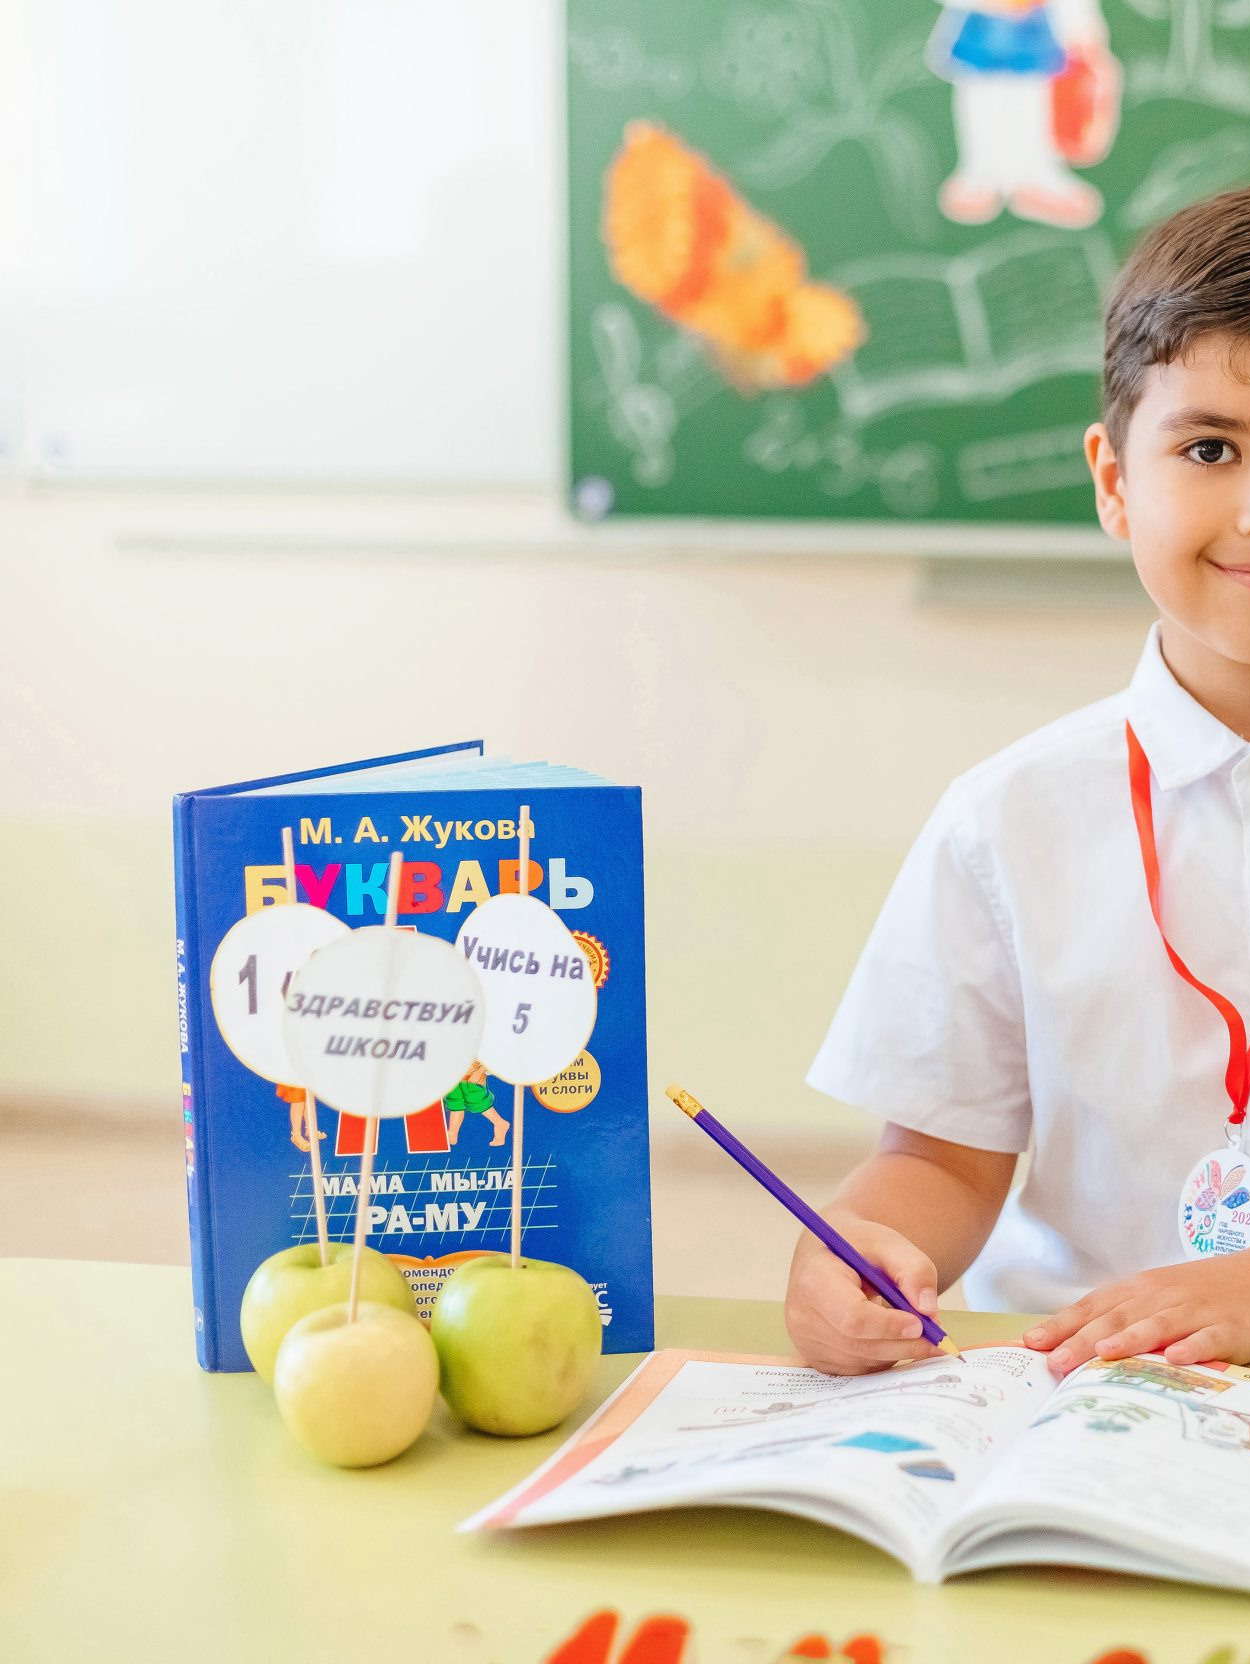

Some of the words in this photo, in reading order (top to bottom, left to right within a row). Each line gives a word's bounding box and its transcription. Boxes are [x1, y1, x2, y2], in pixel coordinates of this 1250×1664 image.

[300, 817, 343, 845] М.
[353, 816, 389, 843] А.
[400, 815, 536, 849] Жукова
[244, 857, 595, 917] БУКВАРЬ
[463, 936, 541, 975] Учись
[550, 954, 584, 980] на
[238, 954, 258, 1016] 1
[178, 982, 189, 1053] ЖУКОВА
[288, 992, 476, 1025] ЗДРАВСТВУЙ
[512, 1003, 532, 1035] 5
[323, 1034, 428, 1062] ШКОЛА
[551, 1071, 589, 1084] уквы
[431, 1170, 515, 1193] МЫ-ЛА
[364, 1201, 487, 1235] РА-МУ
[1218, 1228, 1245, 1238] НАРОДНОГО
